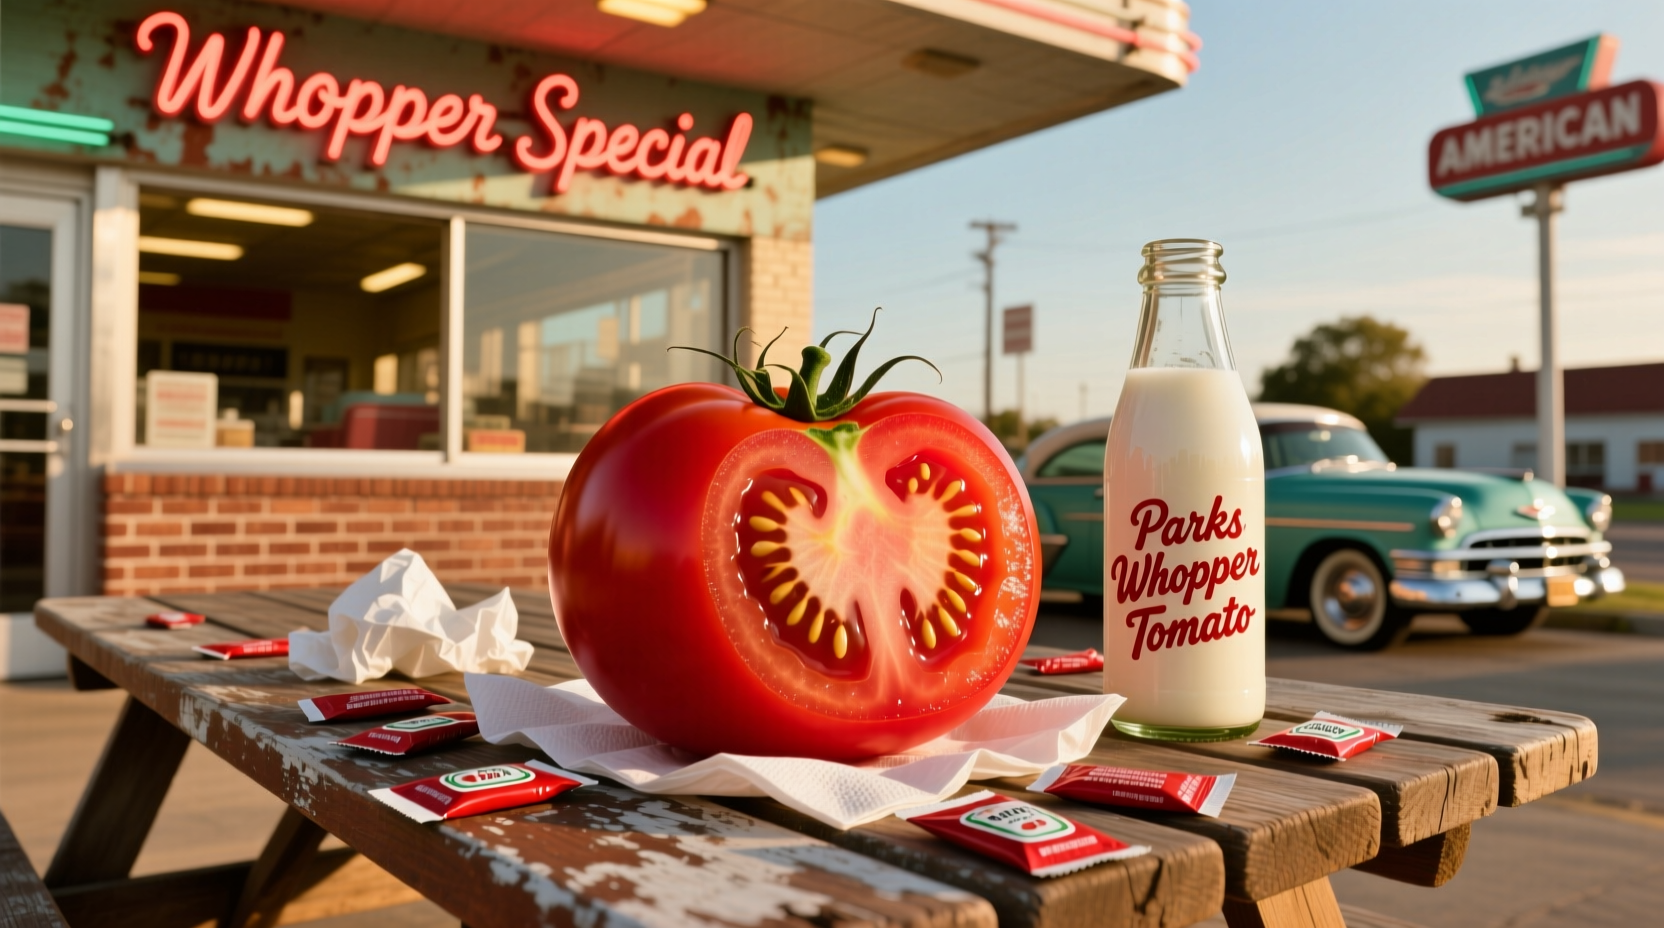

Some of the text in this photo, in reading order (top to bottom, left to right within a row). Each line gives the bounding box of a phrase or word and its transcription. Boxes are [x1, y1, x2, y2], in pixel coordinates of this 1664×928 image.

[136, 11, 753, 194] Whopper Special
[1438, 92, 1641, 176] AMERICAN
[1130, 495, 1243, 551] Parks
[1111, 547, 1260, 606] Whopper
[1126, 596, 1256, 661] Tomato
